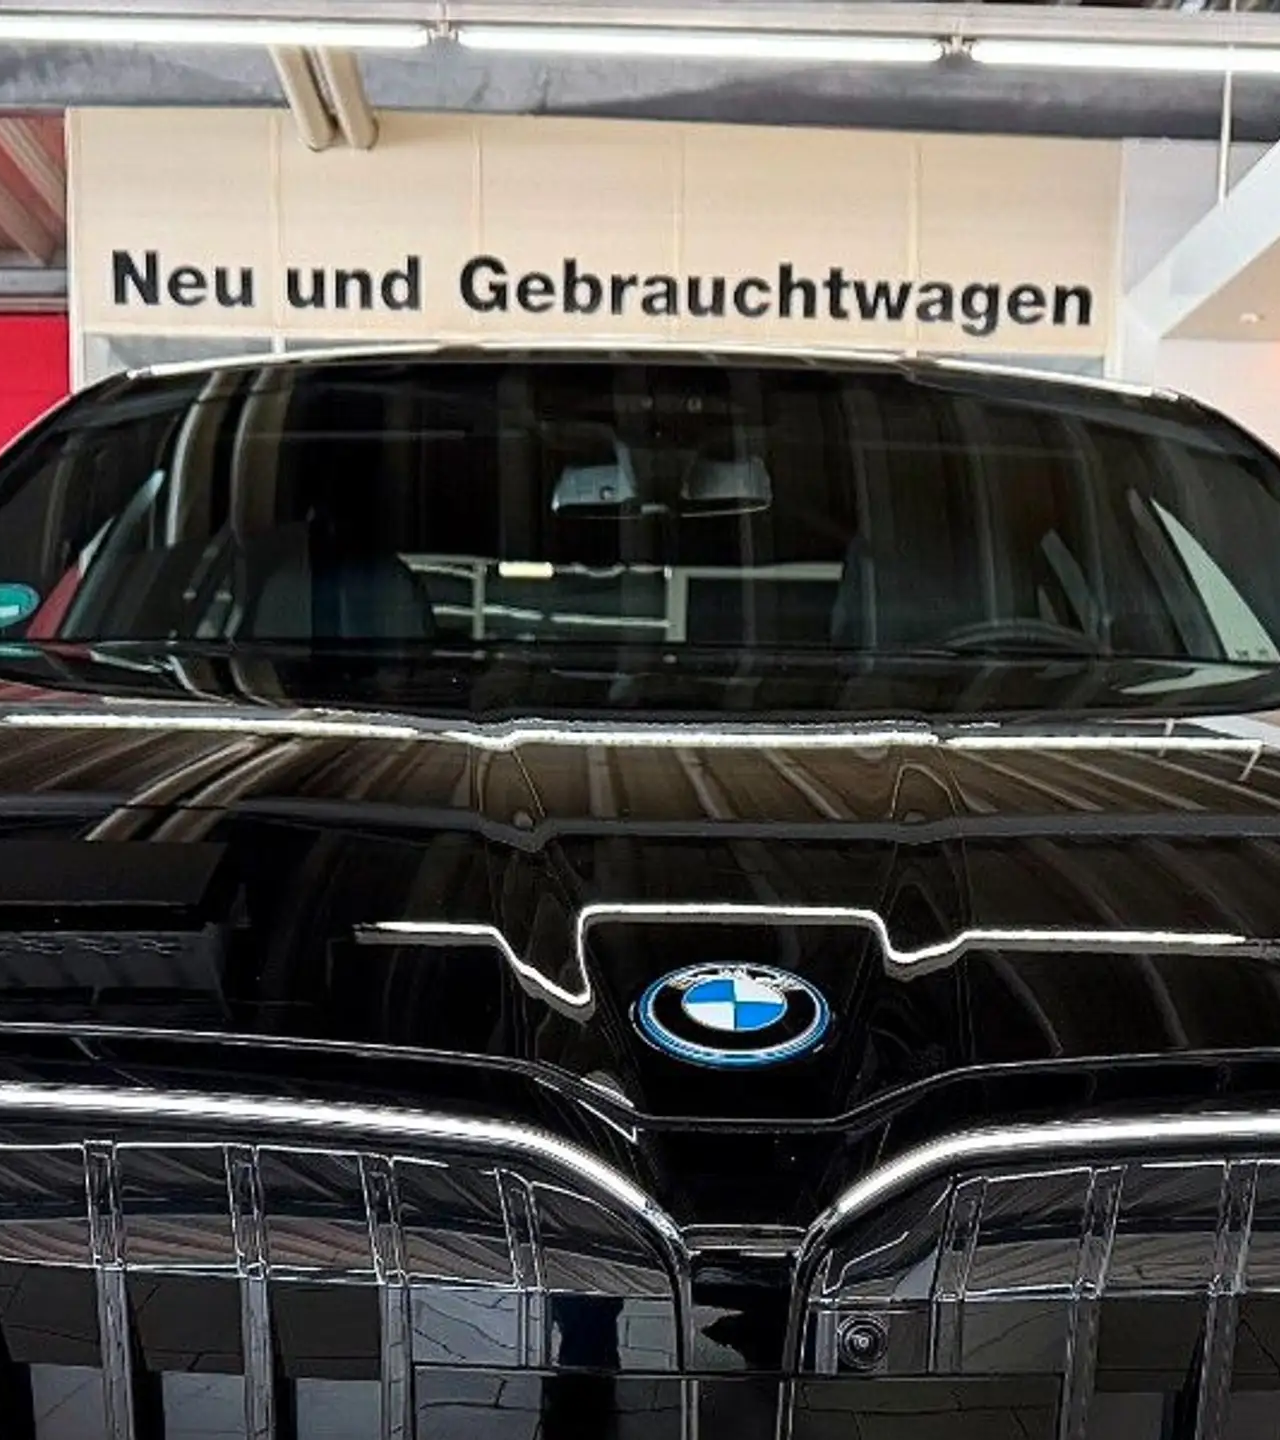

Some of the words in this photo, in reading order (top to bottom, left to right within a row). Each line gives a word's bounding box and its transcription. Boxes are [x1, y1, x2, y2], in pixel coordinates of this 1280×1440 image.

[112, 250, 253, 308] Neu
[286, 255, 420, 311] und
[459, 255, 1093, 336] Gebrauchtwagen
